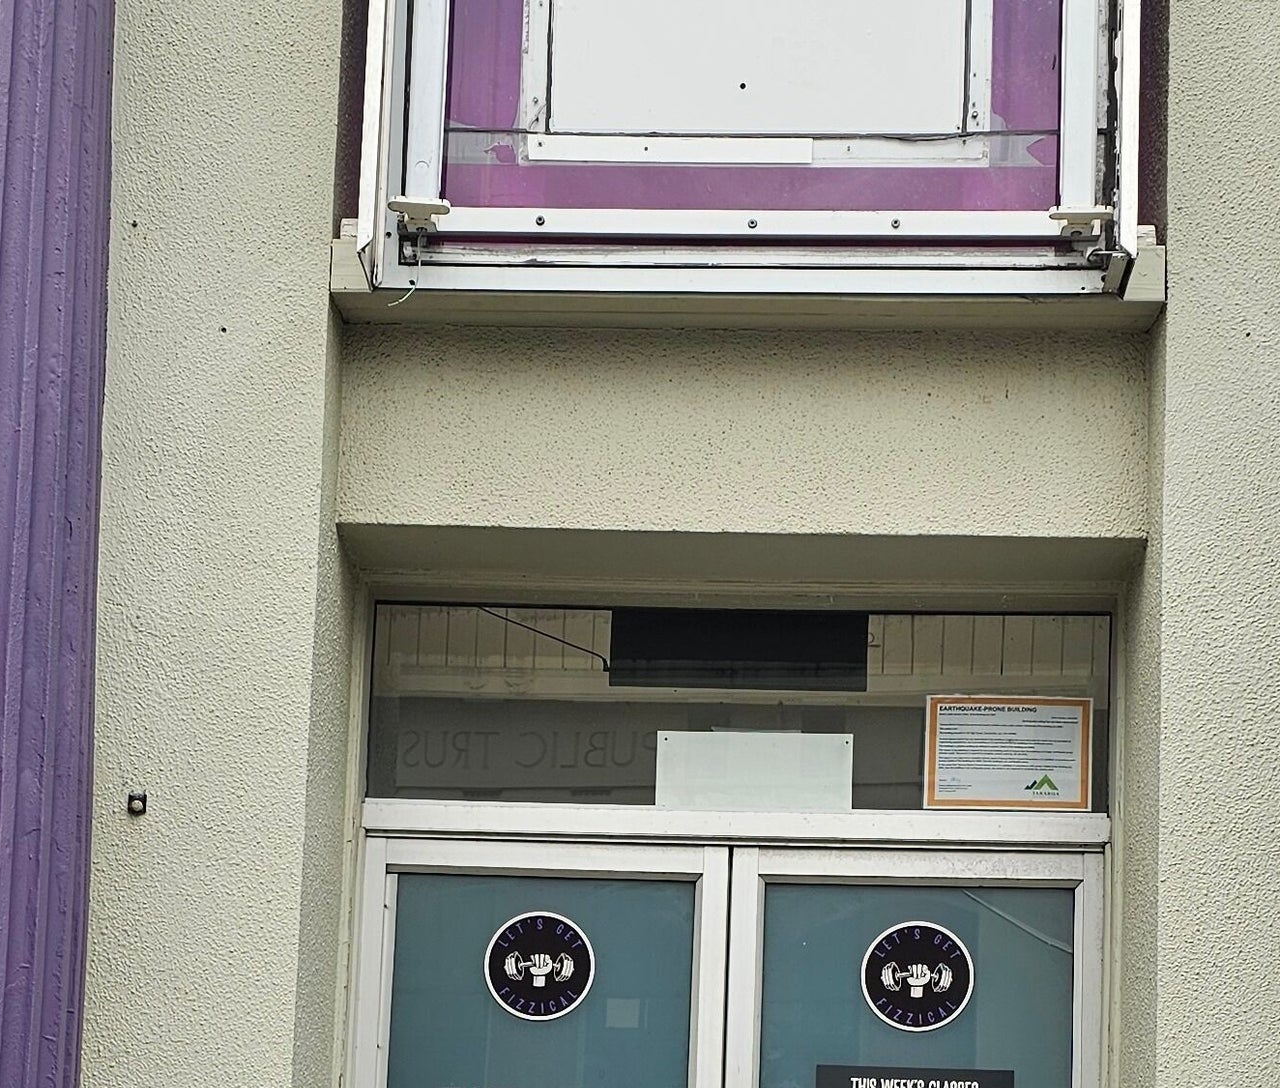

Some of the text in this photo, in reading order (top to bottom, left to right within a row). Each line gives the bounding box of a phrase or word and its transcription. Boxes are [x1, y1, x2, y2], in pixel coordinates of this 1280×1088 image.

[939, 705, 1006, 713] EARTHQUAKE-PRONE
[499, 919, 583, 949] LET'S GET
[875, 928, 961, 959] LET'S GET
[500, 987, 577, 1014] FIZZICAL
[876, 998, 957, 1025] FIZZICAL
